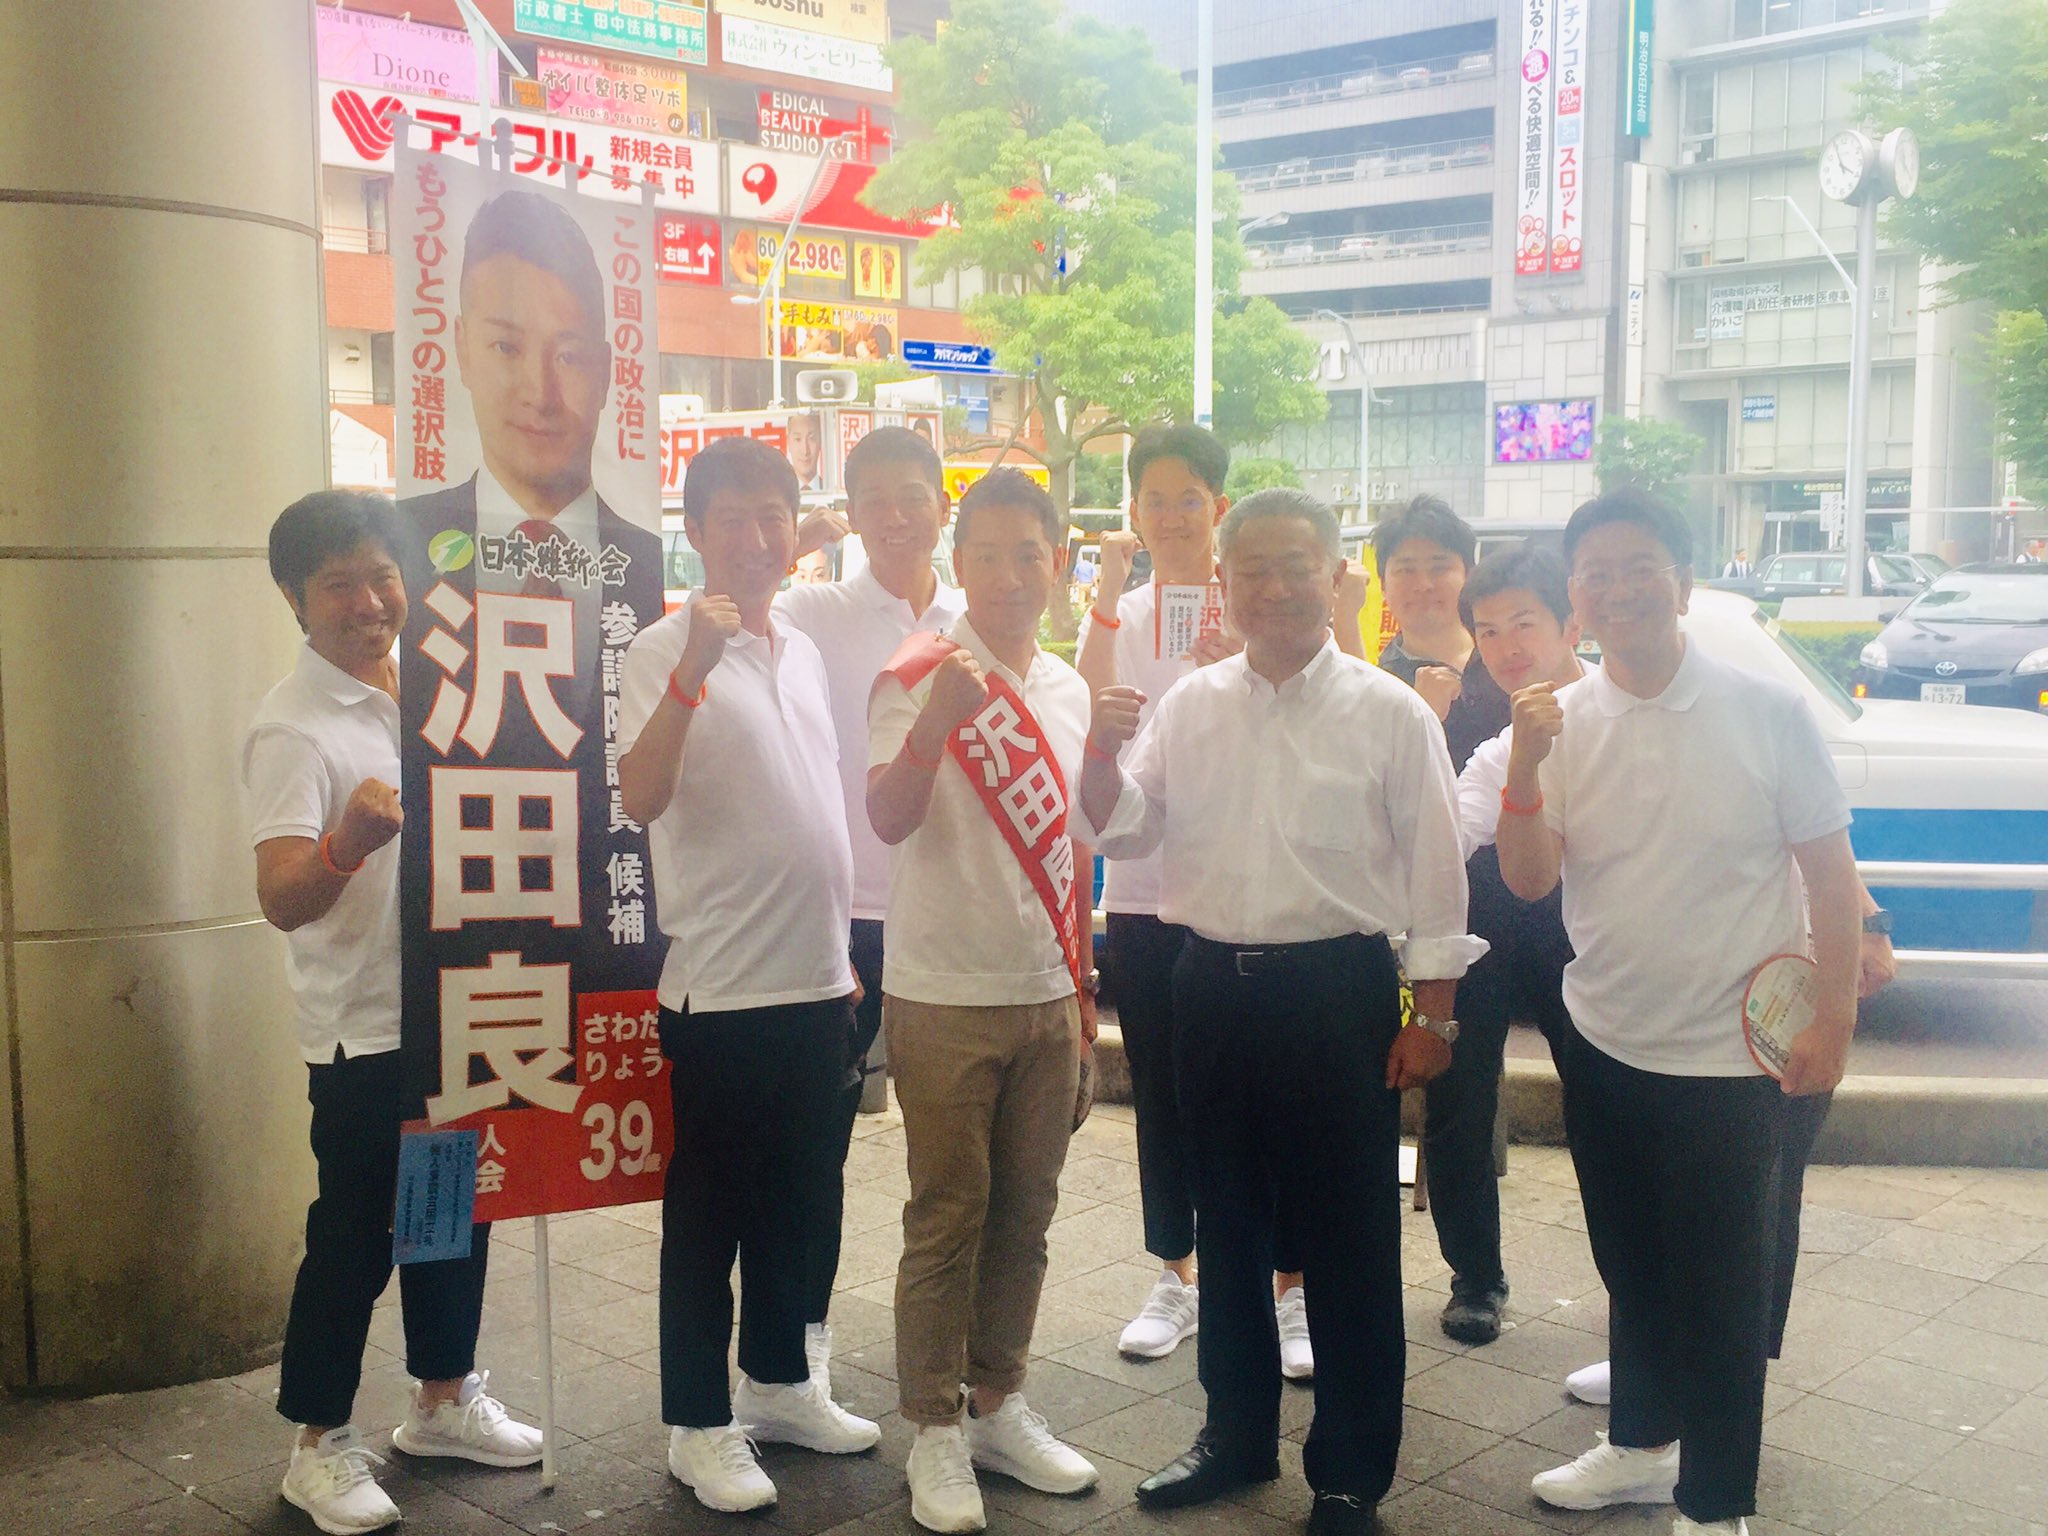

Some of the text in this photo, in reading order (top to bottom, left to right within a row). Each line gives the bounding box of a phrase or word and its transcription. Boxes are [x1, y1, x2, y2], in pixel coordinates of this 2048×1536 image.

[517, 0, 584, 26] 行政書士
[593, 12, 704, 48] 田中法務事務所
[727, 30, 768, 53] 株式会社
[372, 52, 451, 88] Dione
[541, 69, 682, 108] オイル整体足ツボ
[772, 91, 830, 117] EDICAL
[761, 108, 823, 135] BEAUTY
[415, 108, 595, 180] アフル
[609, 135, 694, 171] 新規会員
[761, 130, 819, 154] STUDIO
[1559, 147, 1577, 229] スロット
[664, 221, 686, 240] 3F
[788, 240, 842, 272] 2,980
[1711, 286, 1889, 314] 介護職員初任者研修 医療事座
[412, 161, 448, 484] もうひとつの選択肢
[612, 214, 647, 462] この国の政治に
[1711, 314, 1743, 329] かいご
[478, 531, 632, 589] 日本維新の会
[958, 695, 1075, 914] 沢田良
[417, 579, 586, 1128] 沢田良
[605, 852, 646, 945] 候補
[584, 1009, 660, 1045] さわだ
[585, 1048, 664, 1082] りょう
